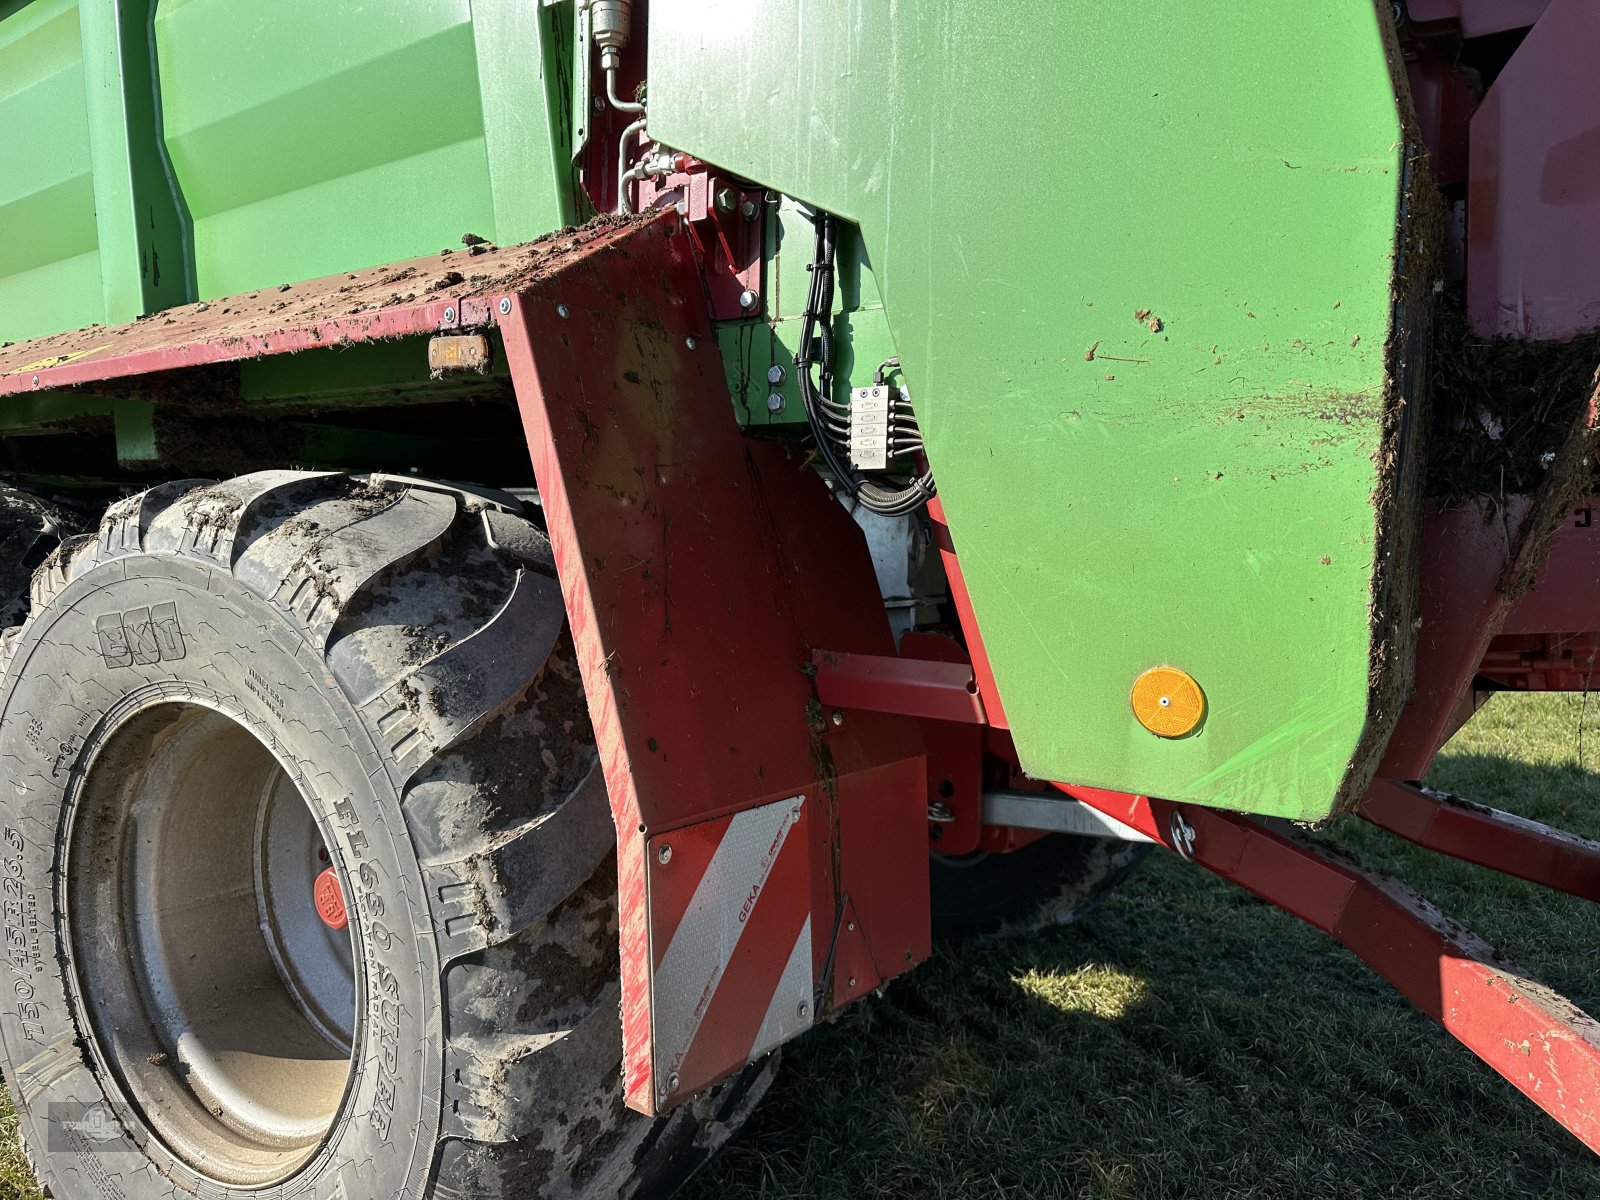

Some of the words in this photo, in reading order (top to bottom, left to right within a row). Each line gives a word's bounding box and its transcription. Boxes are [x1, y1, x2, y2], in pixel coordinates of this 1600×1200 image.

[27, 893, 39, 934] BELTED
[738, 884, 760, 923] GEKA
[31, 938, 43, 972] STEEL
[356, 885, 377, 970] FLOTATION
[371, 980, 379, 1038] RADIAL
[369, 961, 400, 1142] SUPER
